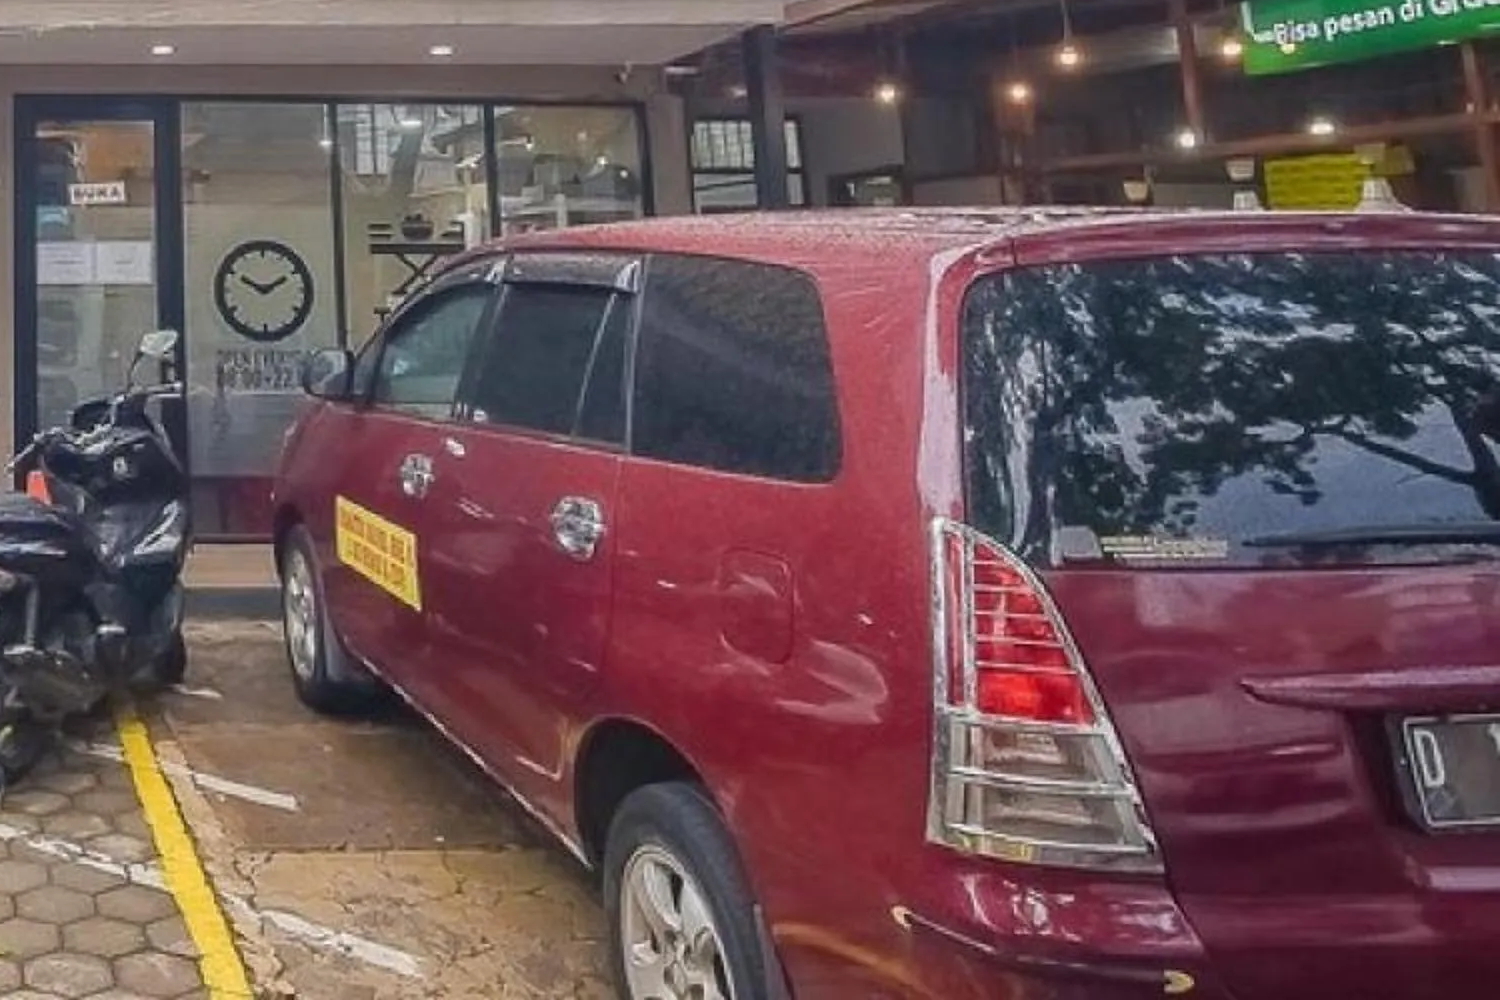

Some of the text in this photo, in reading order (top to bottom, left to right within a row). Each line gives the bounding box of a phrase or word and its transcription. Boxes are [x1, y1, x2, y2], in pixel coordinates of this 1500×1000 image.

[1273, 21, 1319, 45] Bisa
[1323, 6, 1395, 41] pesan
[1414, 728, 1445, 787] D
